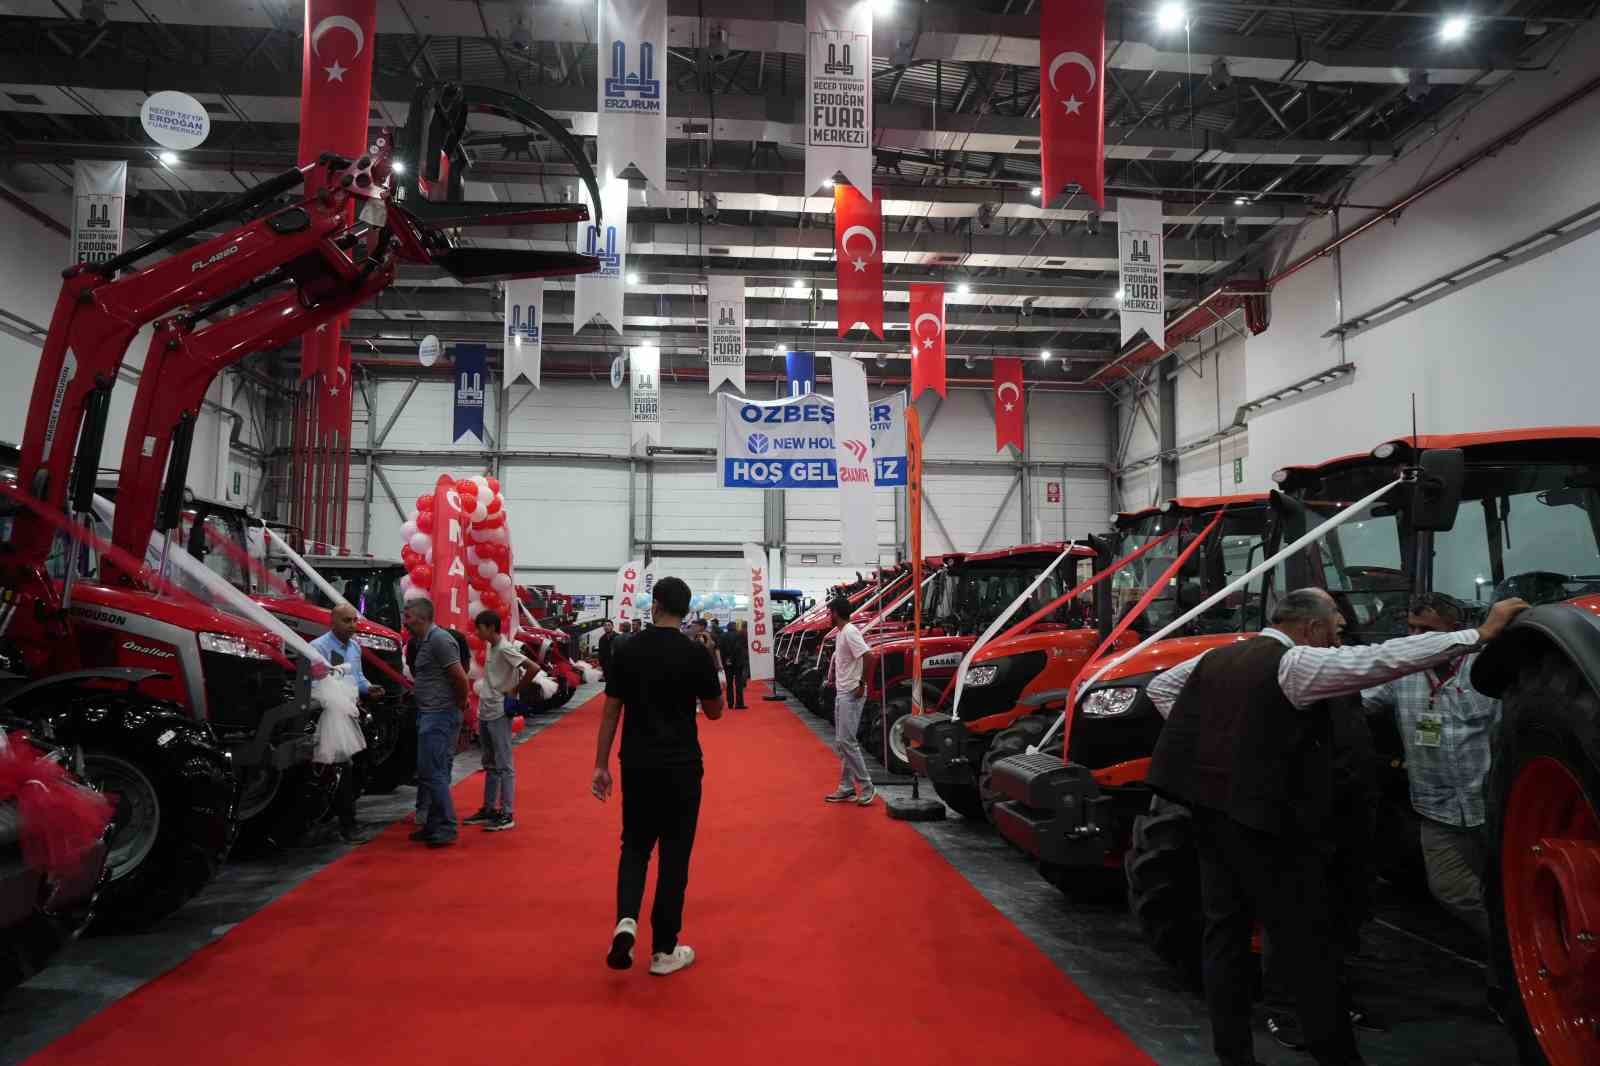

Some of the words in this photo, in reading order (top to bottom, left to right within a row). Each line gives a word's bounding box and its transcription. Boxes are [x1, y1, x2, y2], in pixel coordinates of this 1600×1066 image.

[605, 98, 660, 111] ERZURUM
[814, 91, 864, 107] ERDOĞAN
[149, 114, 203, 130] ERDOĞAN
[814, 106, 864, 128] FUAR
[814, 128, 864, 144] MERKEZİ
[1124, 283, 1158, 299] FUAR
[713, 343, 741, 355] FUAR
[773, 437, 807, 450] NEW
[733, 462, 784, 483] HOŞ
